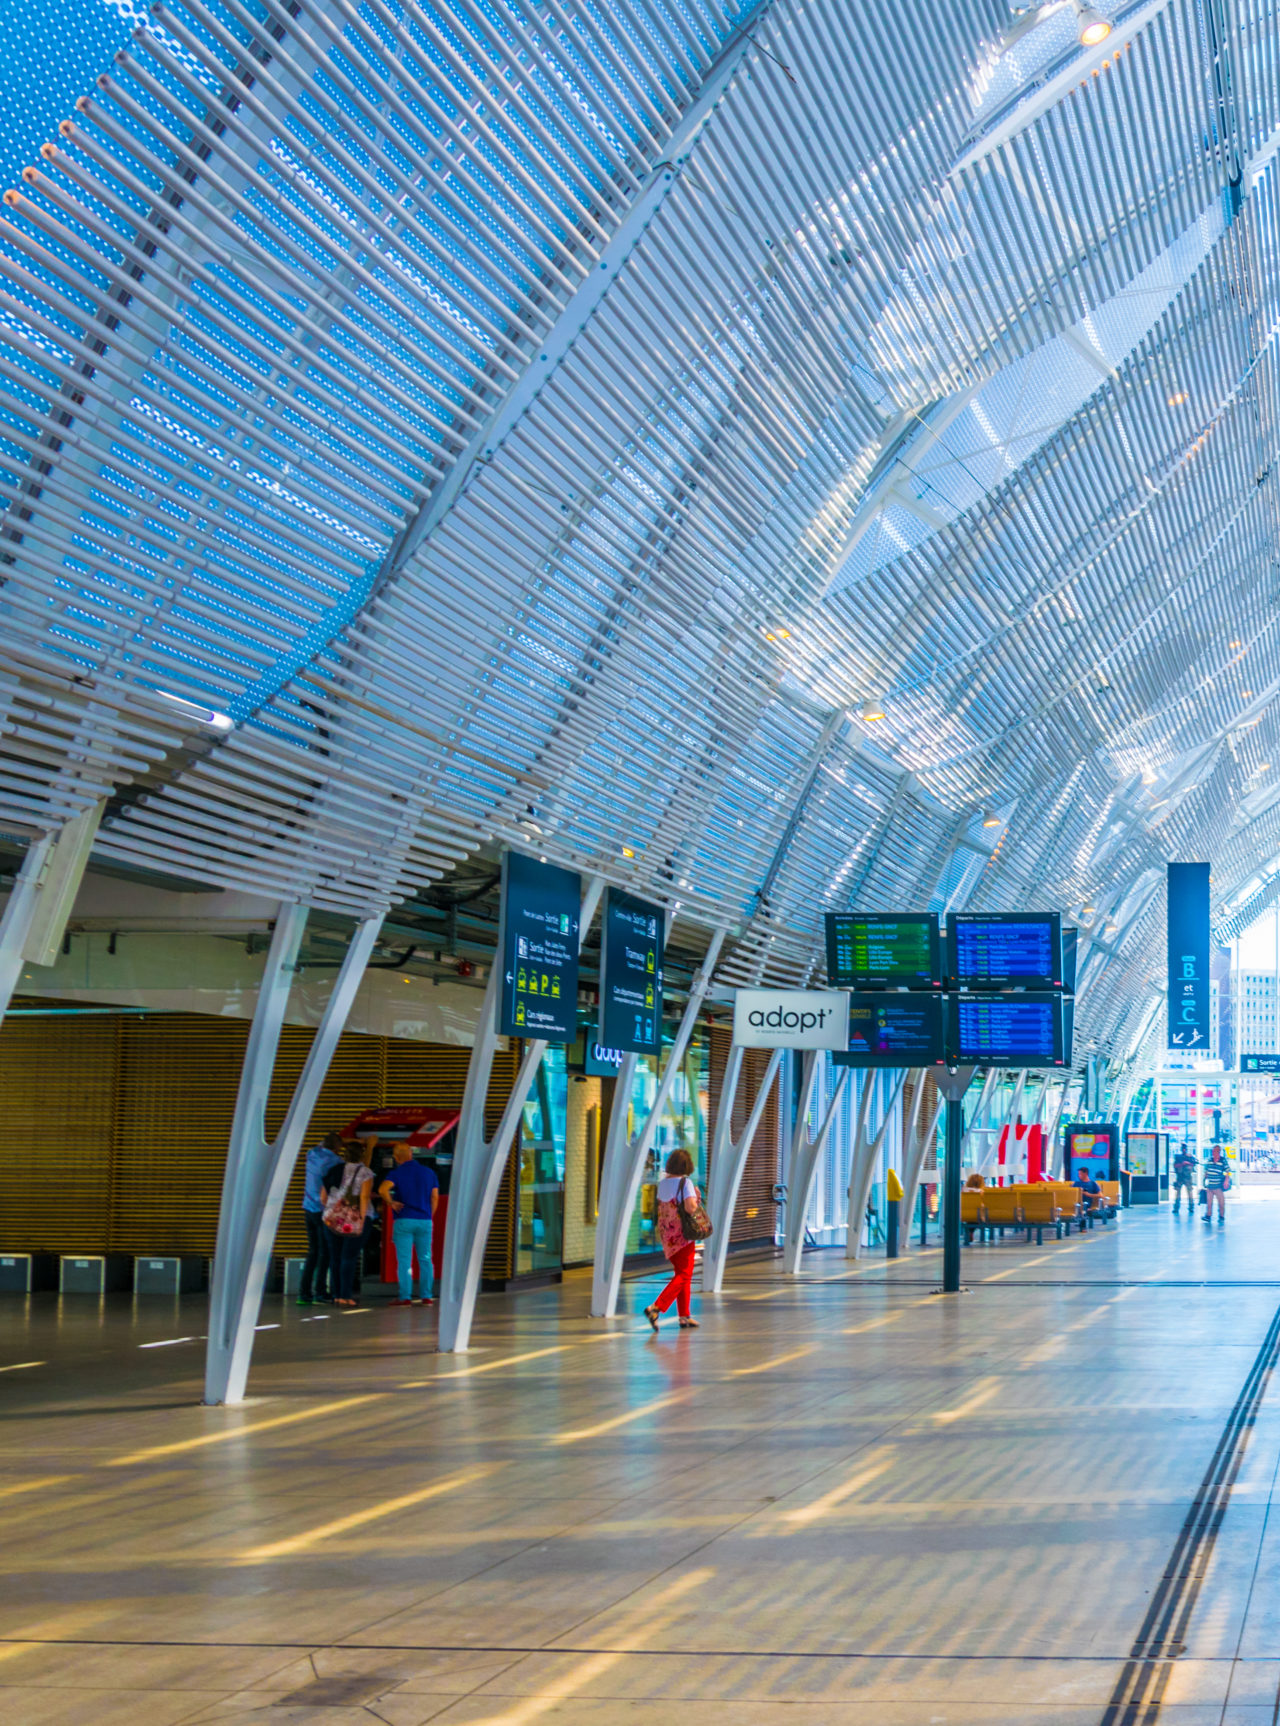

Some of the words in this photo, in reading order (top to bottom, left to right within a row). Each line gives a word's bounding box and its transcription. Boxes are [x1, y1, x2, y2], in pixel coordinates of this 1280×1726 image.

[1183, 963, 1195, 977] B
[541, 974, 549, 993] P
[1184, 984, 1194, 992] et
[1182, 1007, 1195, 1022] C
[635, 1023, 642, 1039] A
